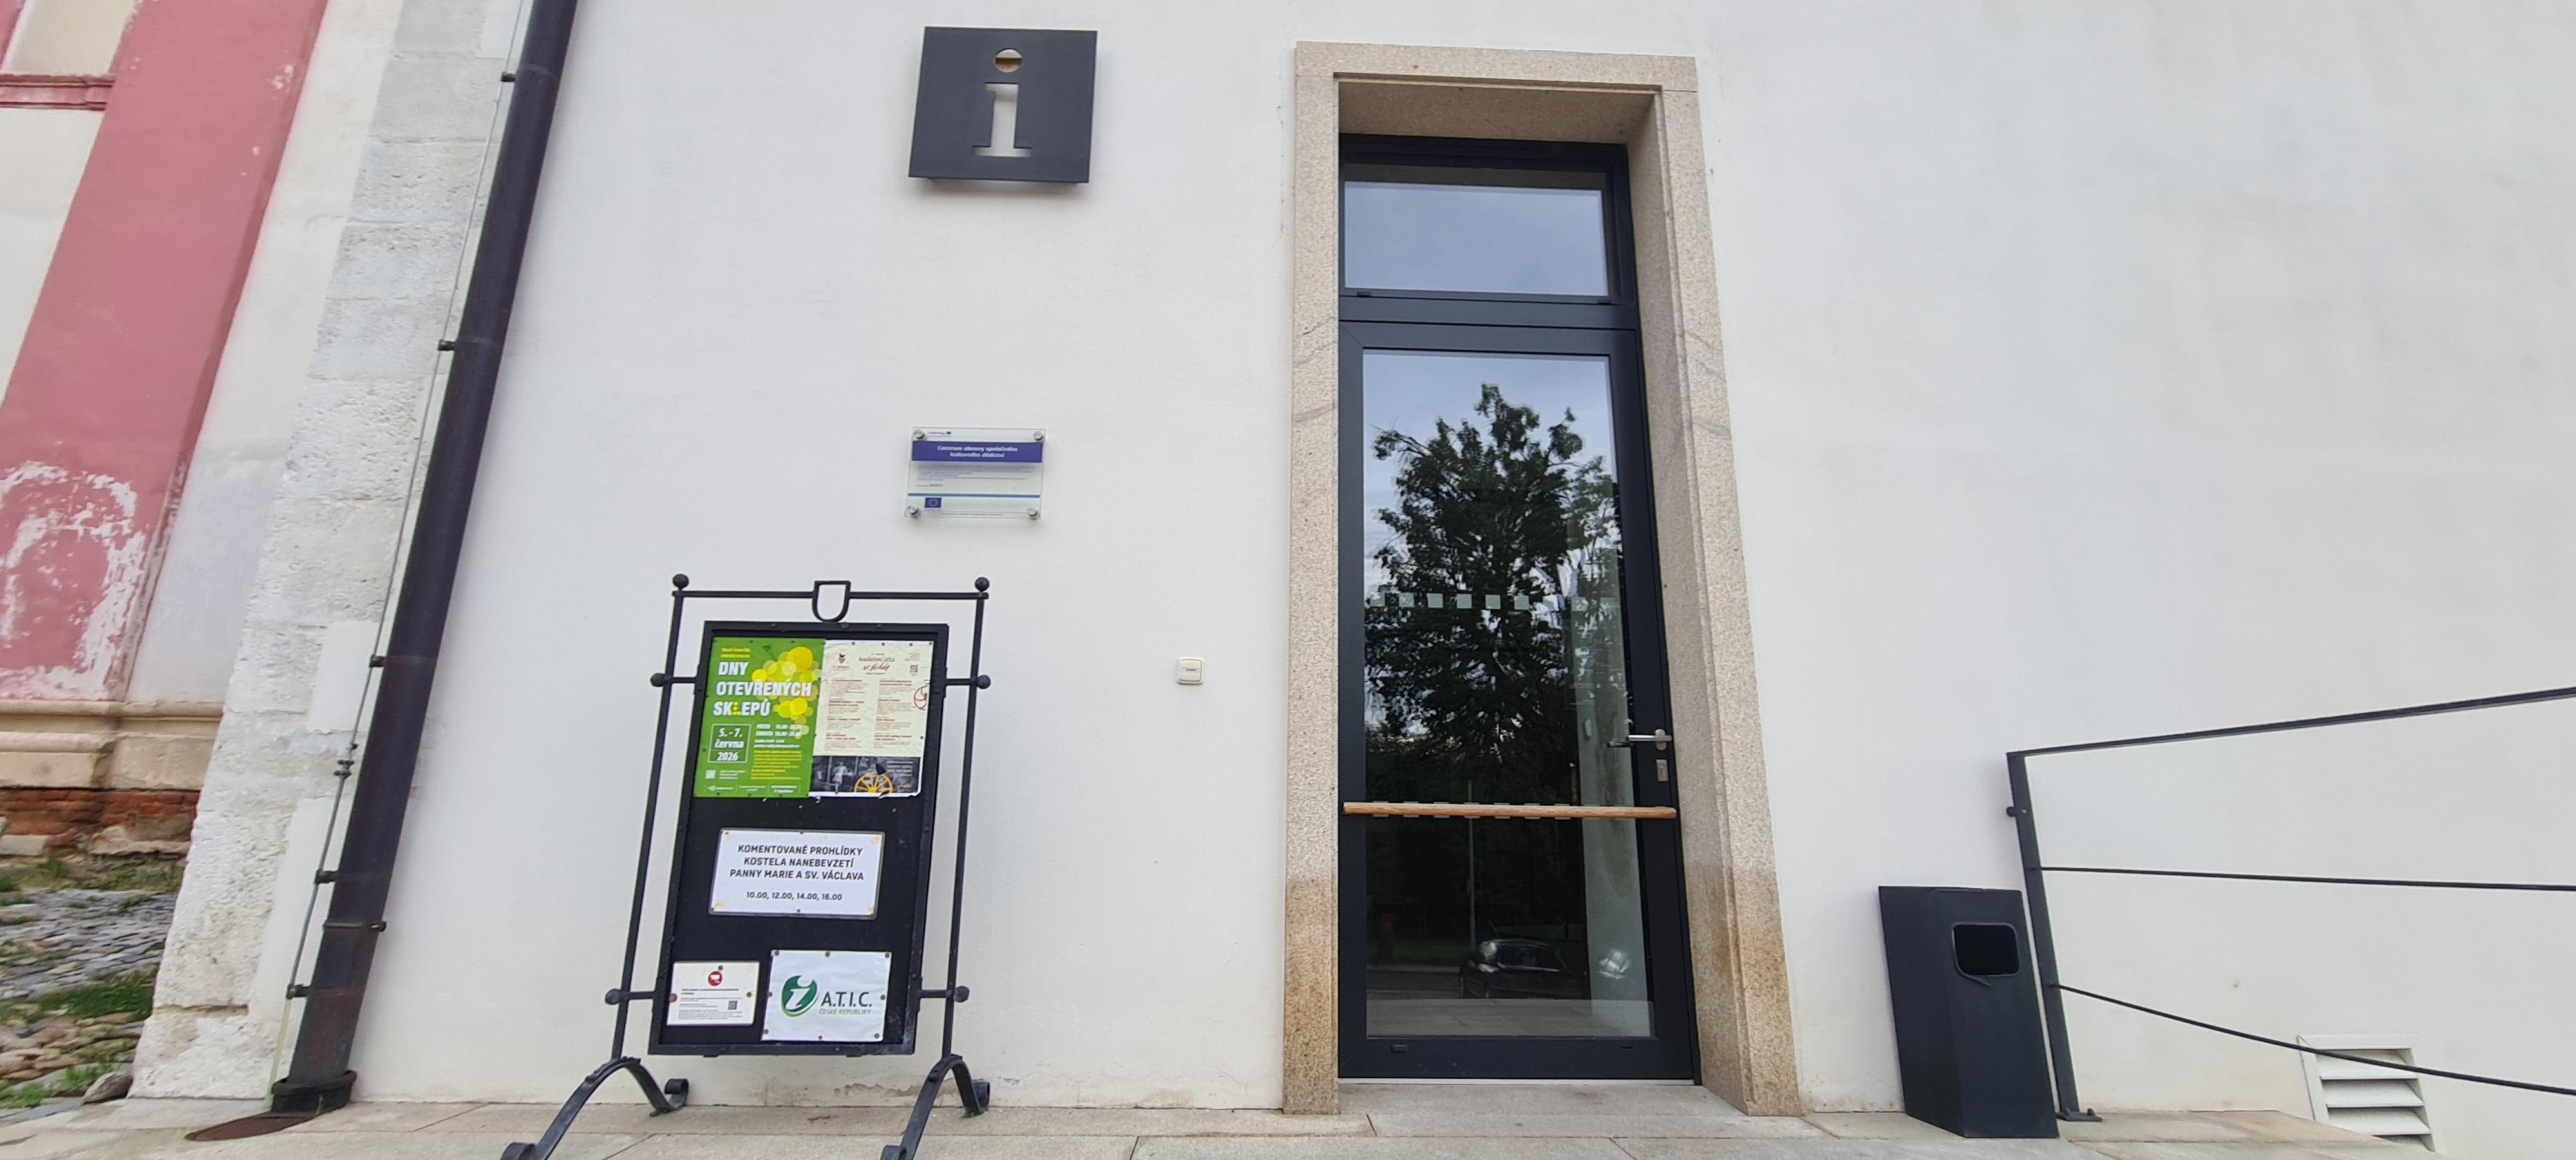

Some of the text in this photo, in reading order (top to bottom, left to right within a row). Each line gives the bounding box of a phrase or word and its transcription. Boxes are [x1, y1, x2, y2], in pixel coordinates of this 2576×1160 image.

[718, 661, 749, 676] DNY
[715, 678, 812, 696] OTEVŘENÝCH
[713, 698, 771, 716] SKLEPŮ
[715, 738, 744, 748] června
[716, 752, 739, 761] 2026
[737, 844, 863, 855] KOMENTOVANÉ PROHLÍDKY
[744, 857, 855, 868] KOSTELA NANEBEVZETÍ
[730, 869, 864, 880] PANNY MARIE A SV. VÁCLAVA
[746, 891, 769, 900] 10.00,
[772, 892, 794, 900] 12.00,
[797, 893, 819, 901] 14.00,
[820, 991, 873, 1007] A.T.I.C.
